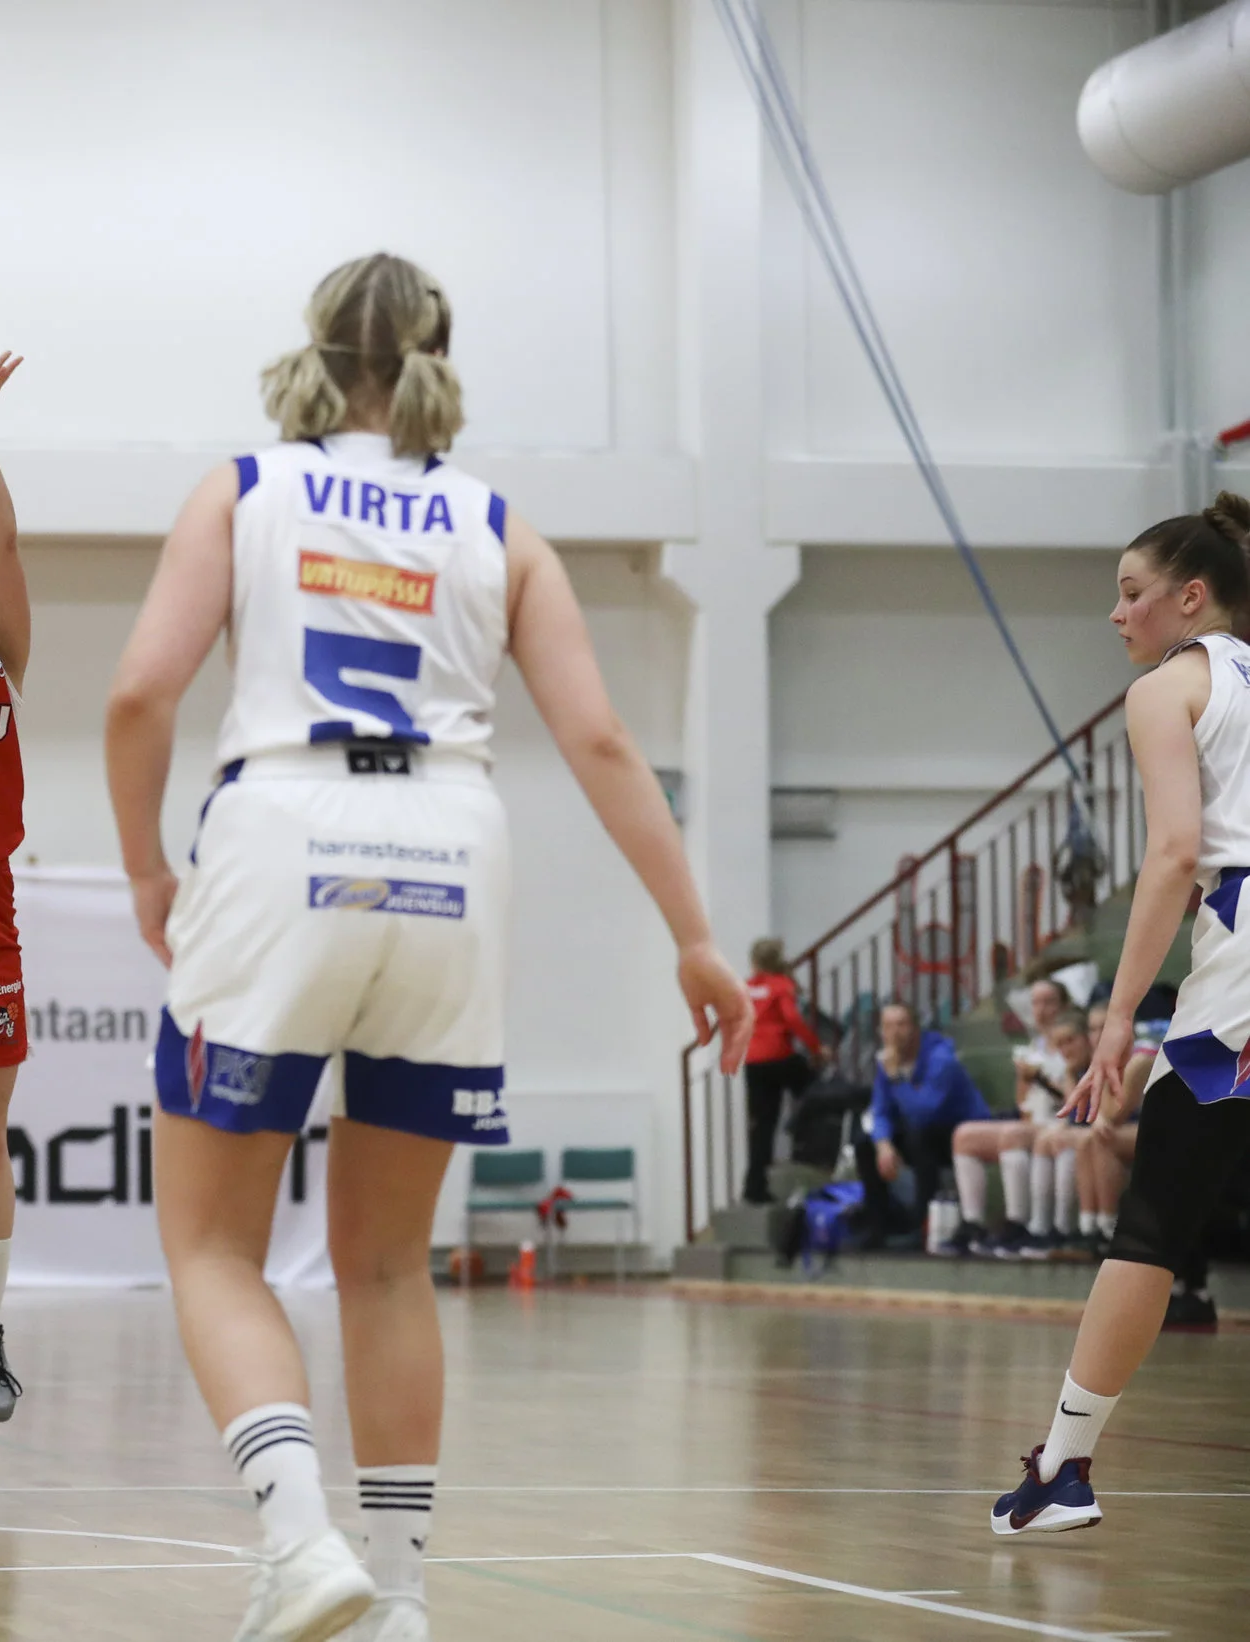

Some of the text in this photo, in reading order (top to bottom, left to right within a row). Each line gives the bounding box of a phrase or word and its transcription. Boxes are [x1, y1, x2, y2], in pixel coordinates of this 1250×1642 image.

[303, 472, 454, 533] VIRTA
[304, 626, 430, 746] 5
[28, 998, 147, 1041] ntaan
